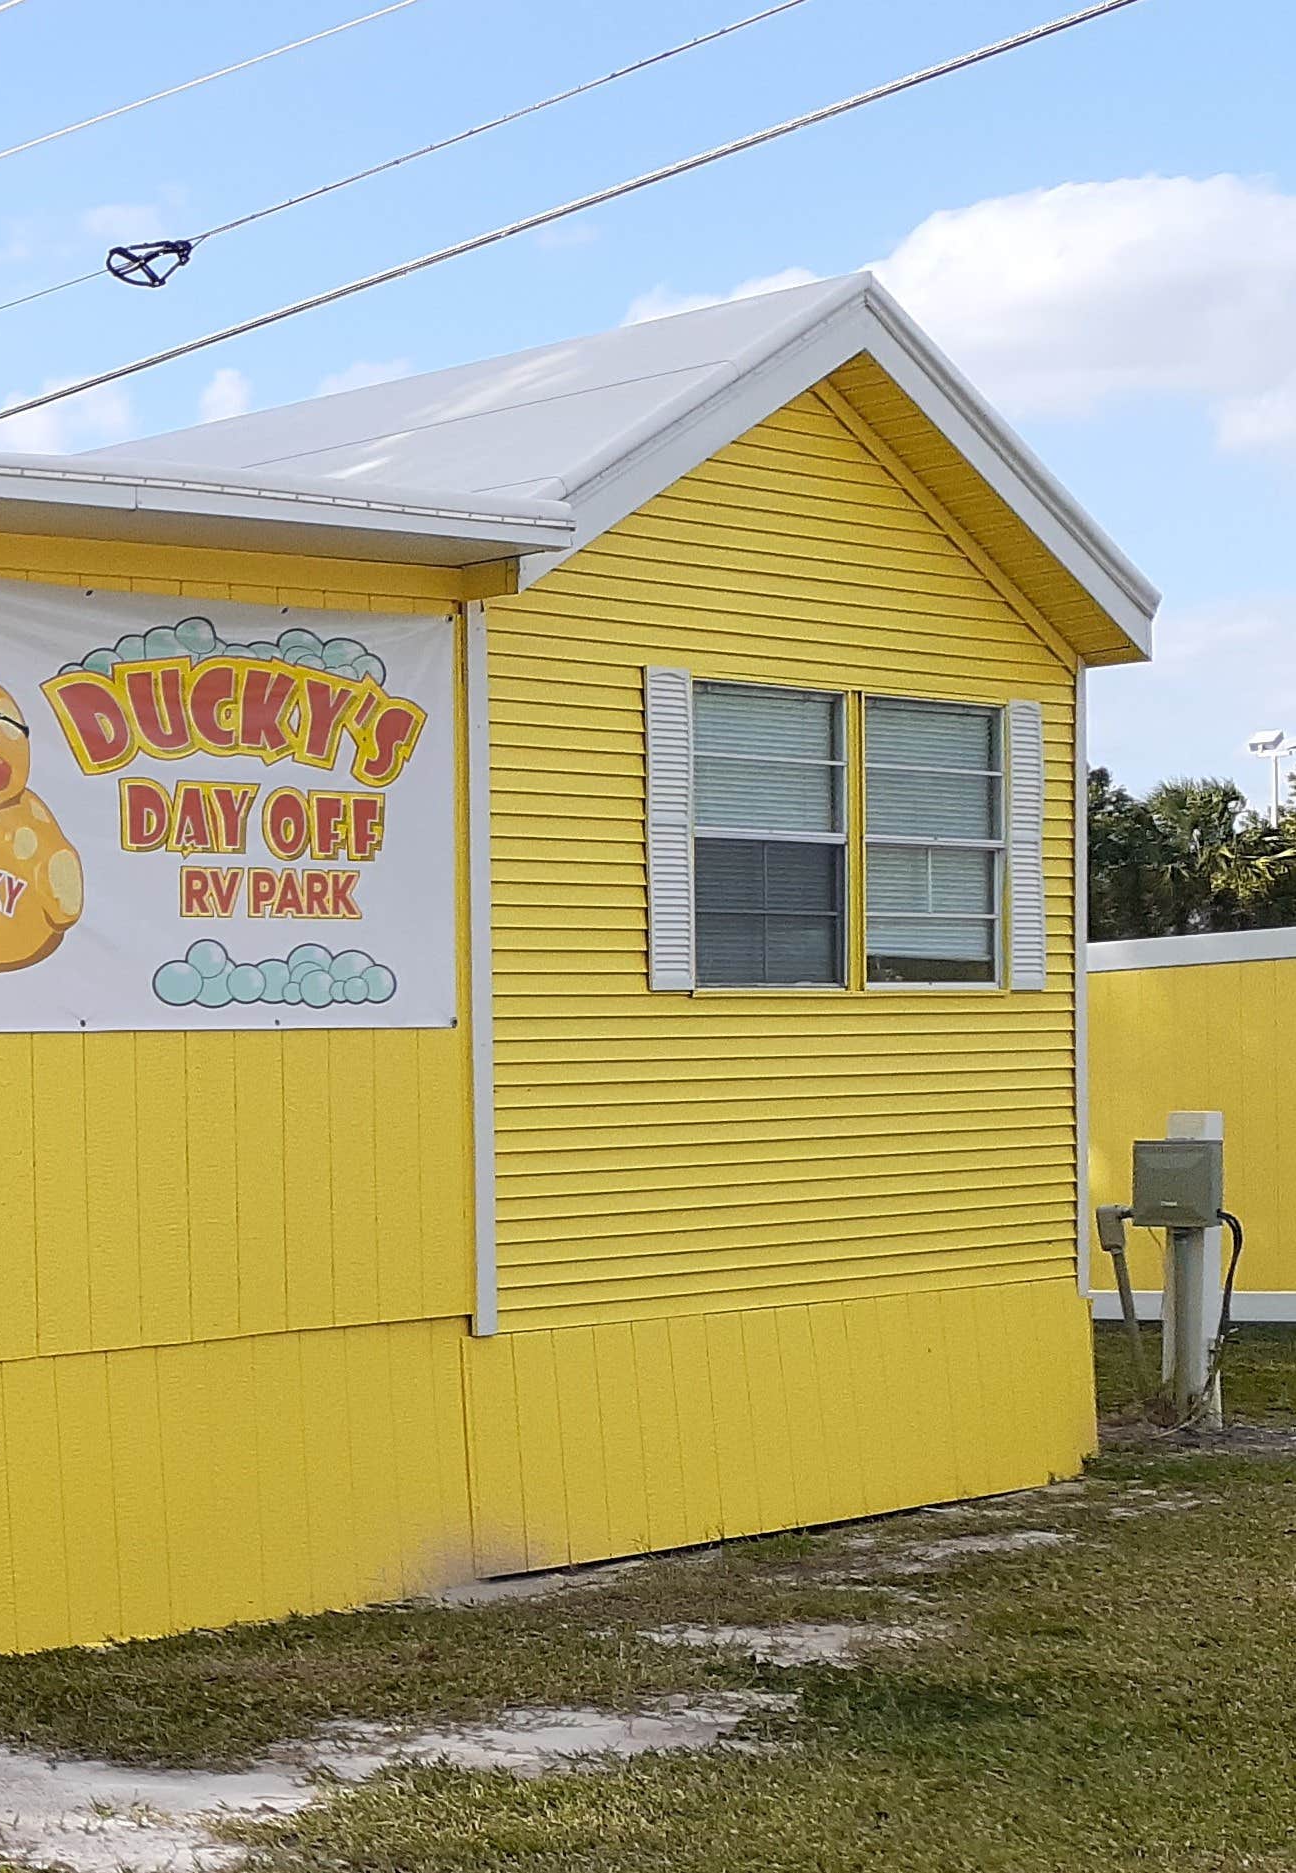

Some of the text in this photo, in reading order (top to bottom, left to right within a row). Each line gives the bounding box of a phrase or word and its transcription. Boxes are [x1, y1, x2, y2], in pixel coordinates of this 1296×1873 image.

[49, 661, 421, 783] DUCKY'S
[123, 780, 383, 858] DAY OFF
[182, 868, 360, 918] RV PARK
